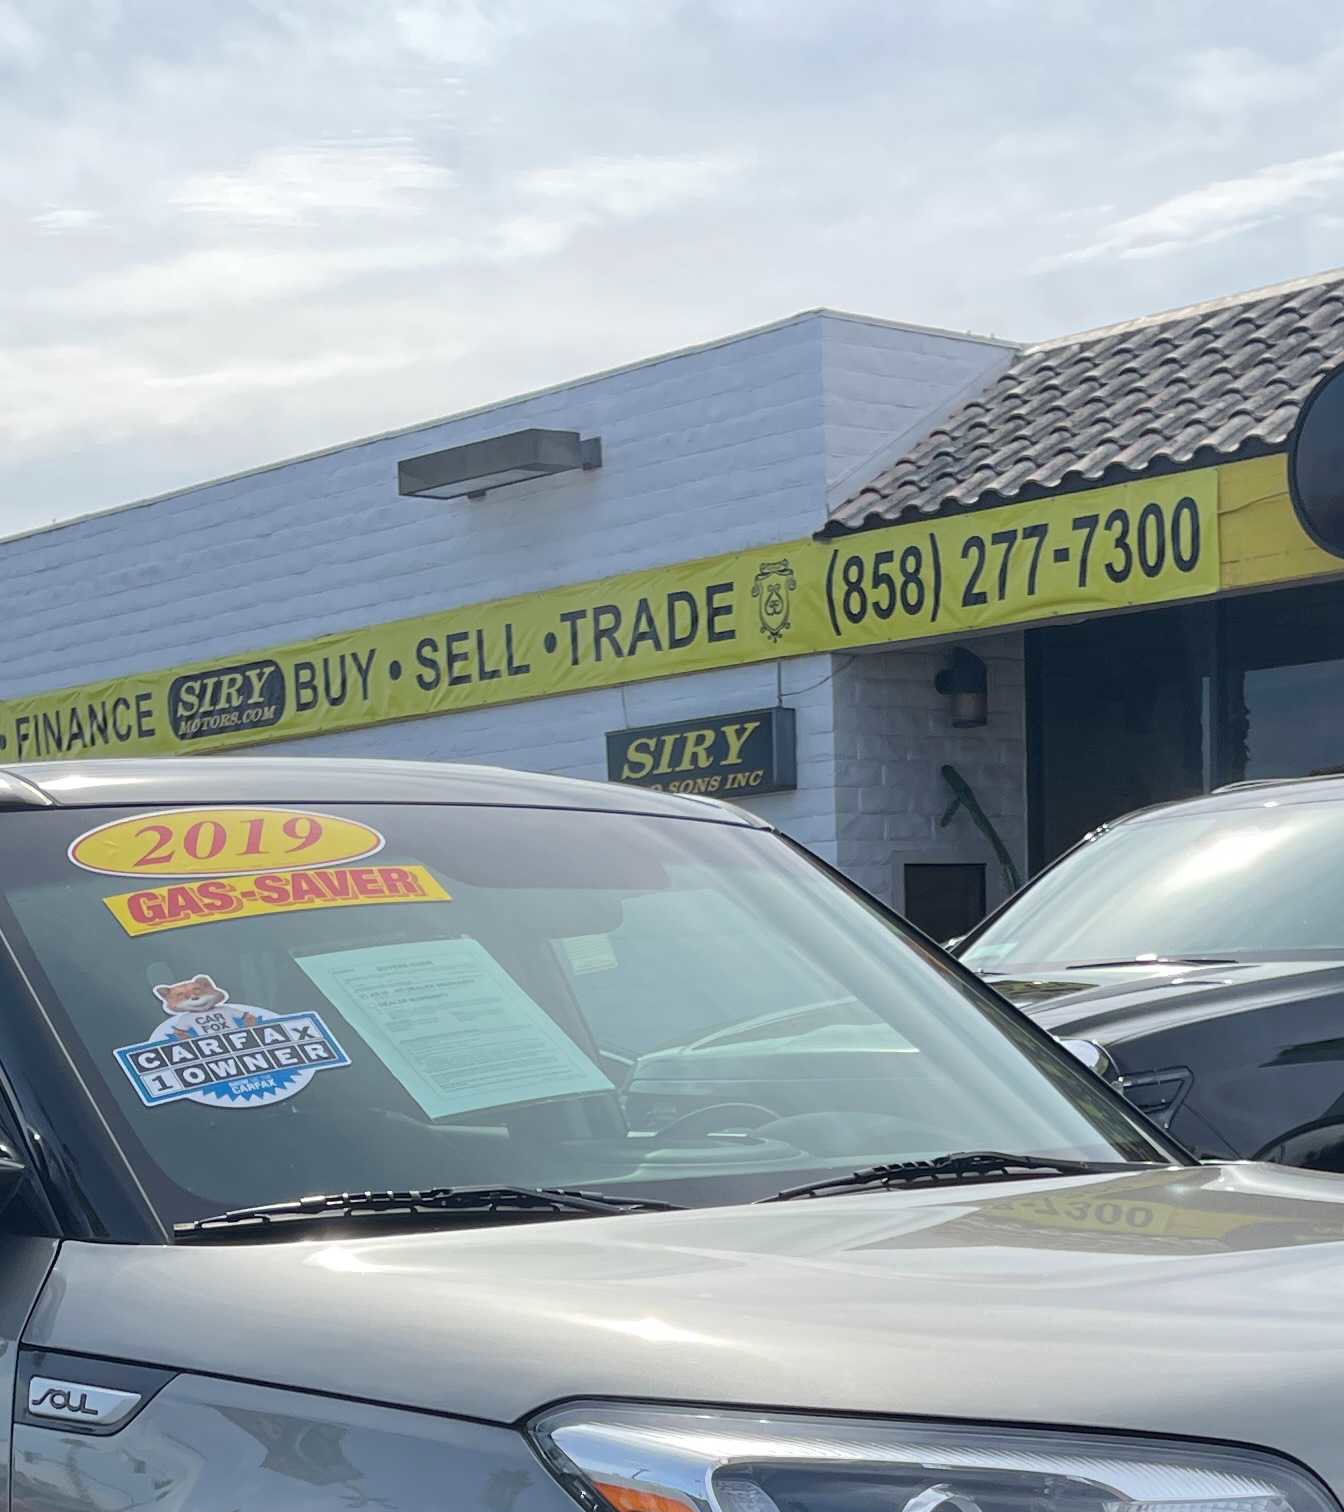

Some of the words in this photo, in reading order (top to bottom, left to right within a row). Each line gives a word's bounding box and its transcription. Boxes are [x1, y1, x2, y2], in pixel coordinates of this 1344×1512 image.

[826, 533, 942, 636] (858)
[961, 496, 1200, 608] 277-7300
[294, 648, 377, 712] BUY
[416, 623, 530, 691] SELL
[559, 581, 737, 666] TRADE
[176, 666, 276, 719] SIRY
[15, 692, 153, 760] FINANCE
[178, 705, 277, 736] MOTORS.COM
[621, 722, 760, 781] SIRY
[668, 775, 722, 794] SONS
[725, 769, 763, 789] INC
[132, 815, 324, 868] 2019
[127, 865, 426, 927] GAS-SAVER
[194, 1012, 226, 1026] CAR
[203, 1022, 231, 1034] FOX
[137, 1025, 320, 1070] CARFAX
[151, 1073, 179, 1092] 1
[182, 1043, 331, 1085] OWNER
[31, 1387, 99, 1416] SOUL
